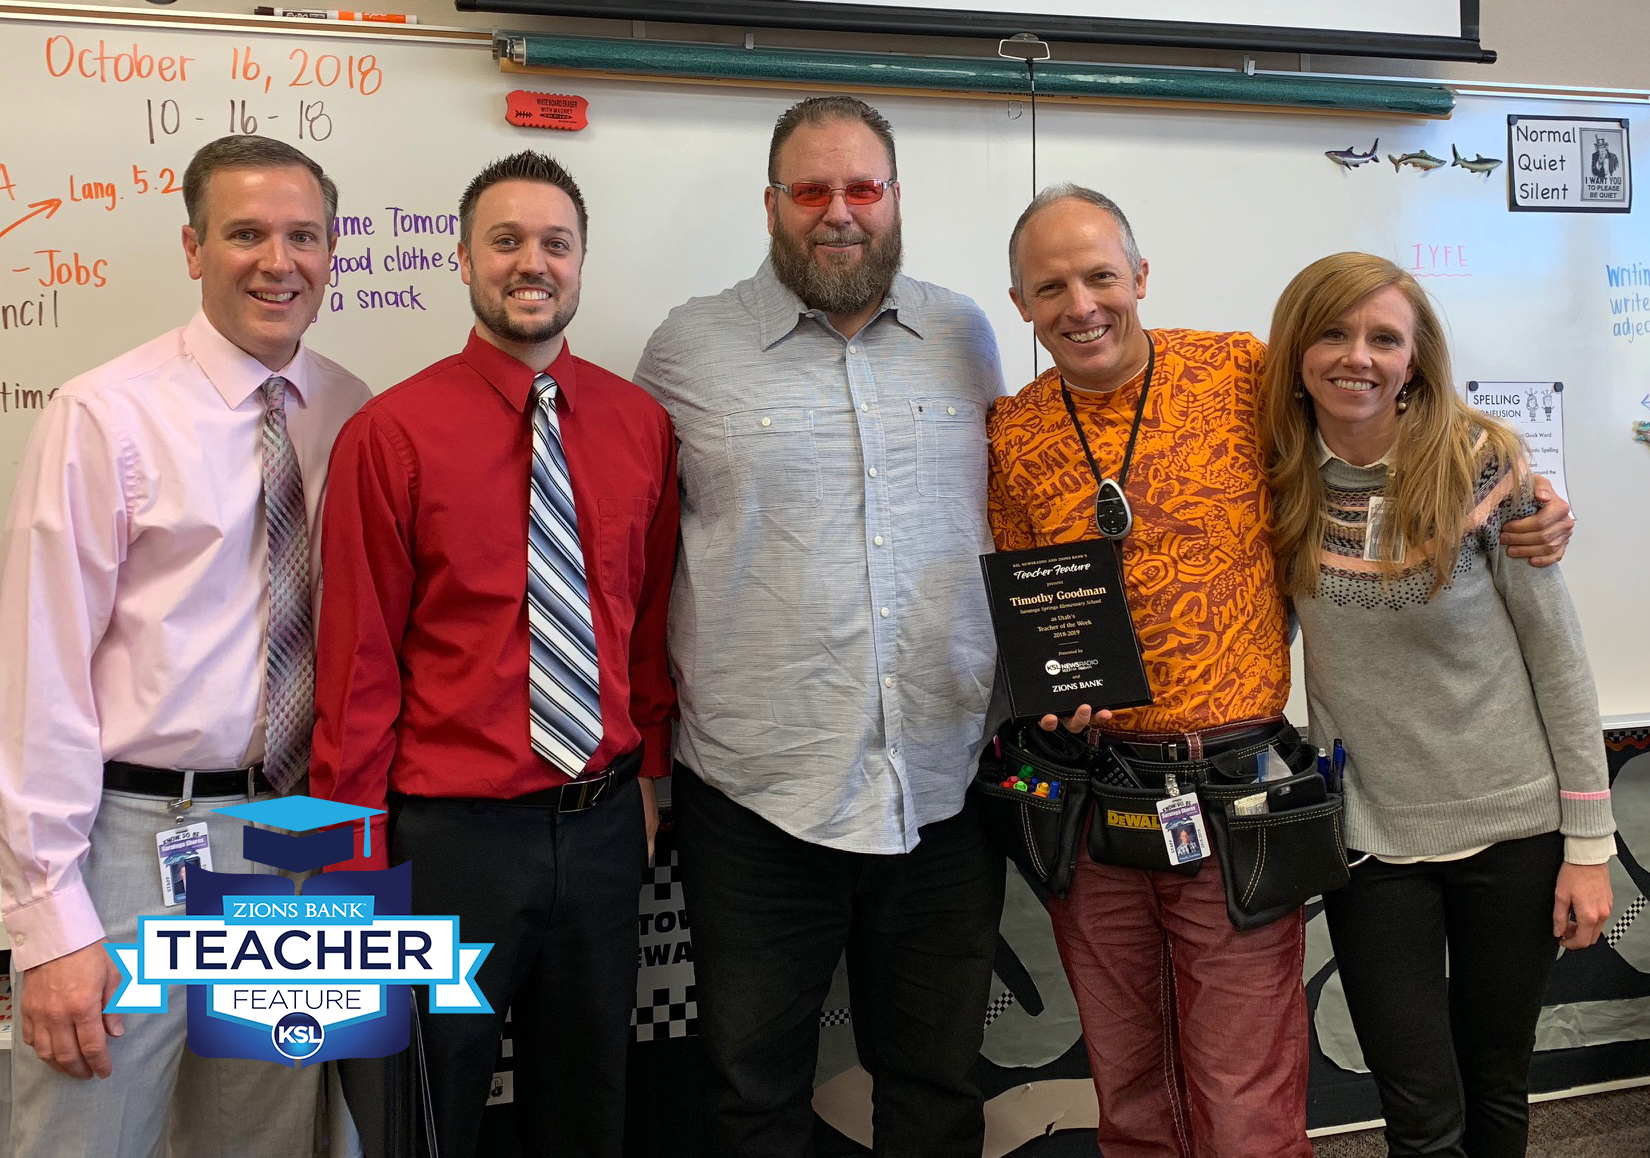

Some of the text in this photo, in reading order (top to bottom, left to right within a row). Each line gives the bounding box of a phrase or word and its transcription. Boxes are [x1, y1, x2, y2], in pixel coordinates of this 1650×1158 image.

[46, 35, 383, 95] October 16, 2018
[536, 98, 578, 109] WHITE BOARD ERASER
[553, 107, 573, 115] MAGNET
[147, 99, 181, 144] 10
[229, 99, 258, 135] 16
[299, 100, 333, 141] 18
[1516, 125, 1576, 143] Normal
[1518, 153, 1566, 172] Quiet
[69, 164, 184, 212] Lang. 5.2
[1589, 177, 1608, 185] WANT
[1609, 177, 1622, 185] YOU
[1519, 182, 1569, 200] Silent
[385, 207, 459, 237] Tomor
[383, 244, 459, 272] clothes
[330, 285, 427, 312] a snack
[1473, 394, 1520, 405] SPELLING
[1541, 447, 1559, 455] Spelling
[1013, 563, 1091, 580] Teacher Feature
[1010, 586, 1107, 607] Timothy Goodman
[1059, 601, 1086, 609] Elementary
[1037, 624, 1059, 632] Teacher
[1076, 619, 1092, 627] Week
[1053, 629, 1081, 639] 2018-2019
[1061, 659, 1099, 670] NEWSRADIO
[1052, 679, 1104, 693] ZIONS BANK
